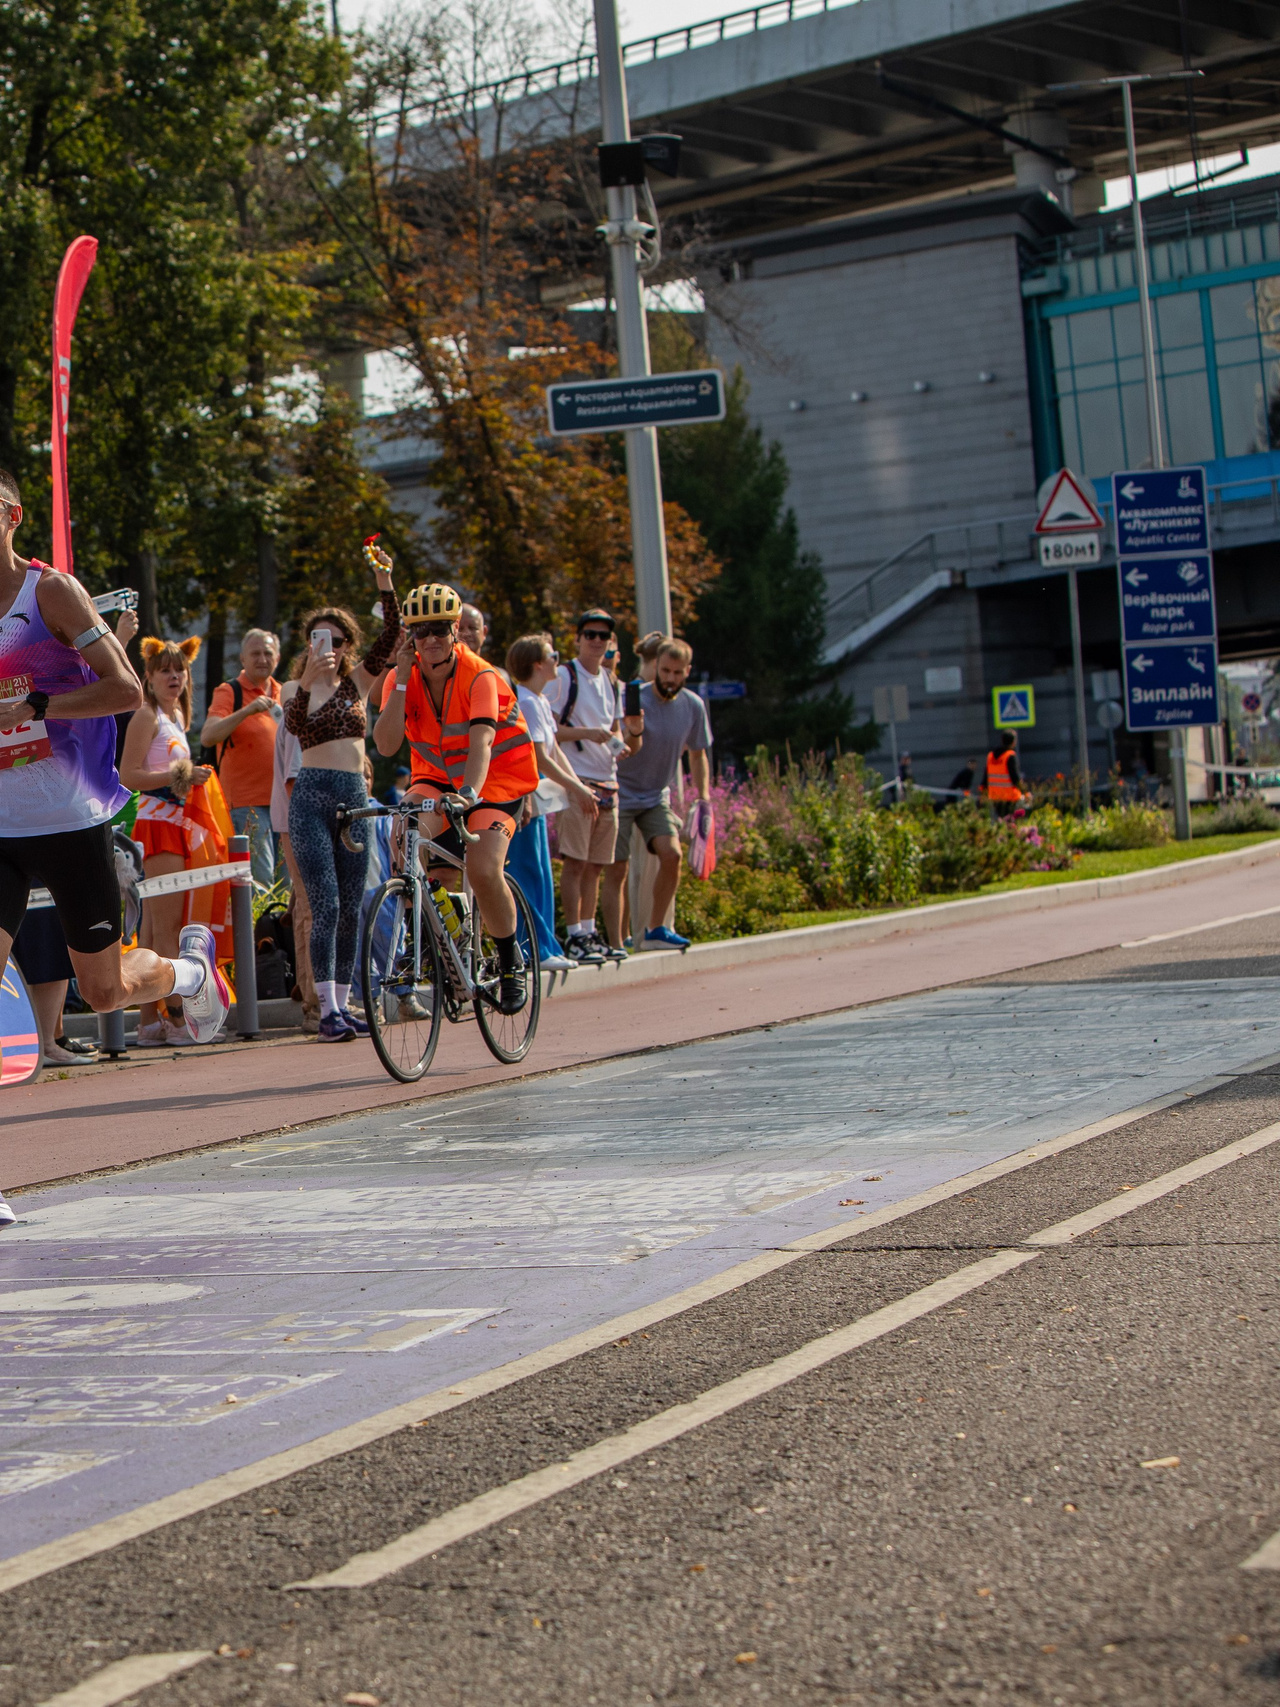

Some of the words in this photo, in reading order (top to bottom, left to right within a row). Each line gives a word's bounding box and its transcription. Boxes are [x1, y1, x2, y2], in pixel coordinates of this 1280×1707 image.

[574, 391, 623, 404] Ресторан
[576, 404, 628, 416] Restaurant
[1120, 505, 1203, 519] Аквакомплекс
[1124, 517, 1201, 533] «Лужники»
[1125, 535, 1165, 547] Aquatic
[1166, 532, 1201, 544] Center
[1124, 588, 1210, 608] Верёвочный
[1150, 606, 1185, 620] парк
[1142, 622, 1168, 635] Rope
[1170, 620, 1195, 634] park
[1131, 682, 1213, 704] Зиплайн
[1155, 709, 1194, 722] Zipline
